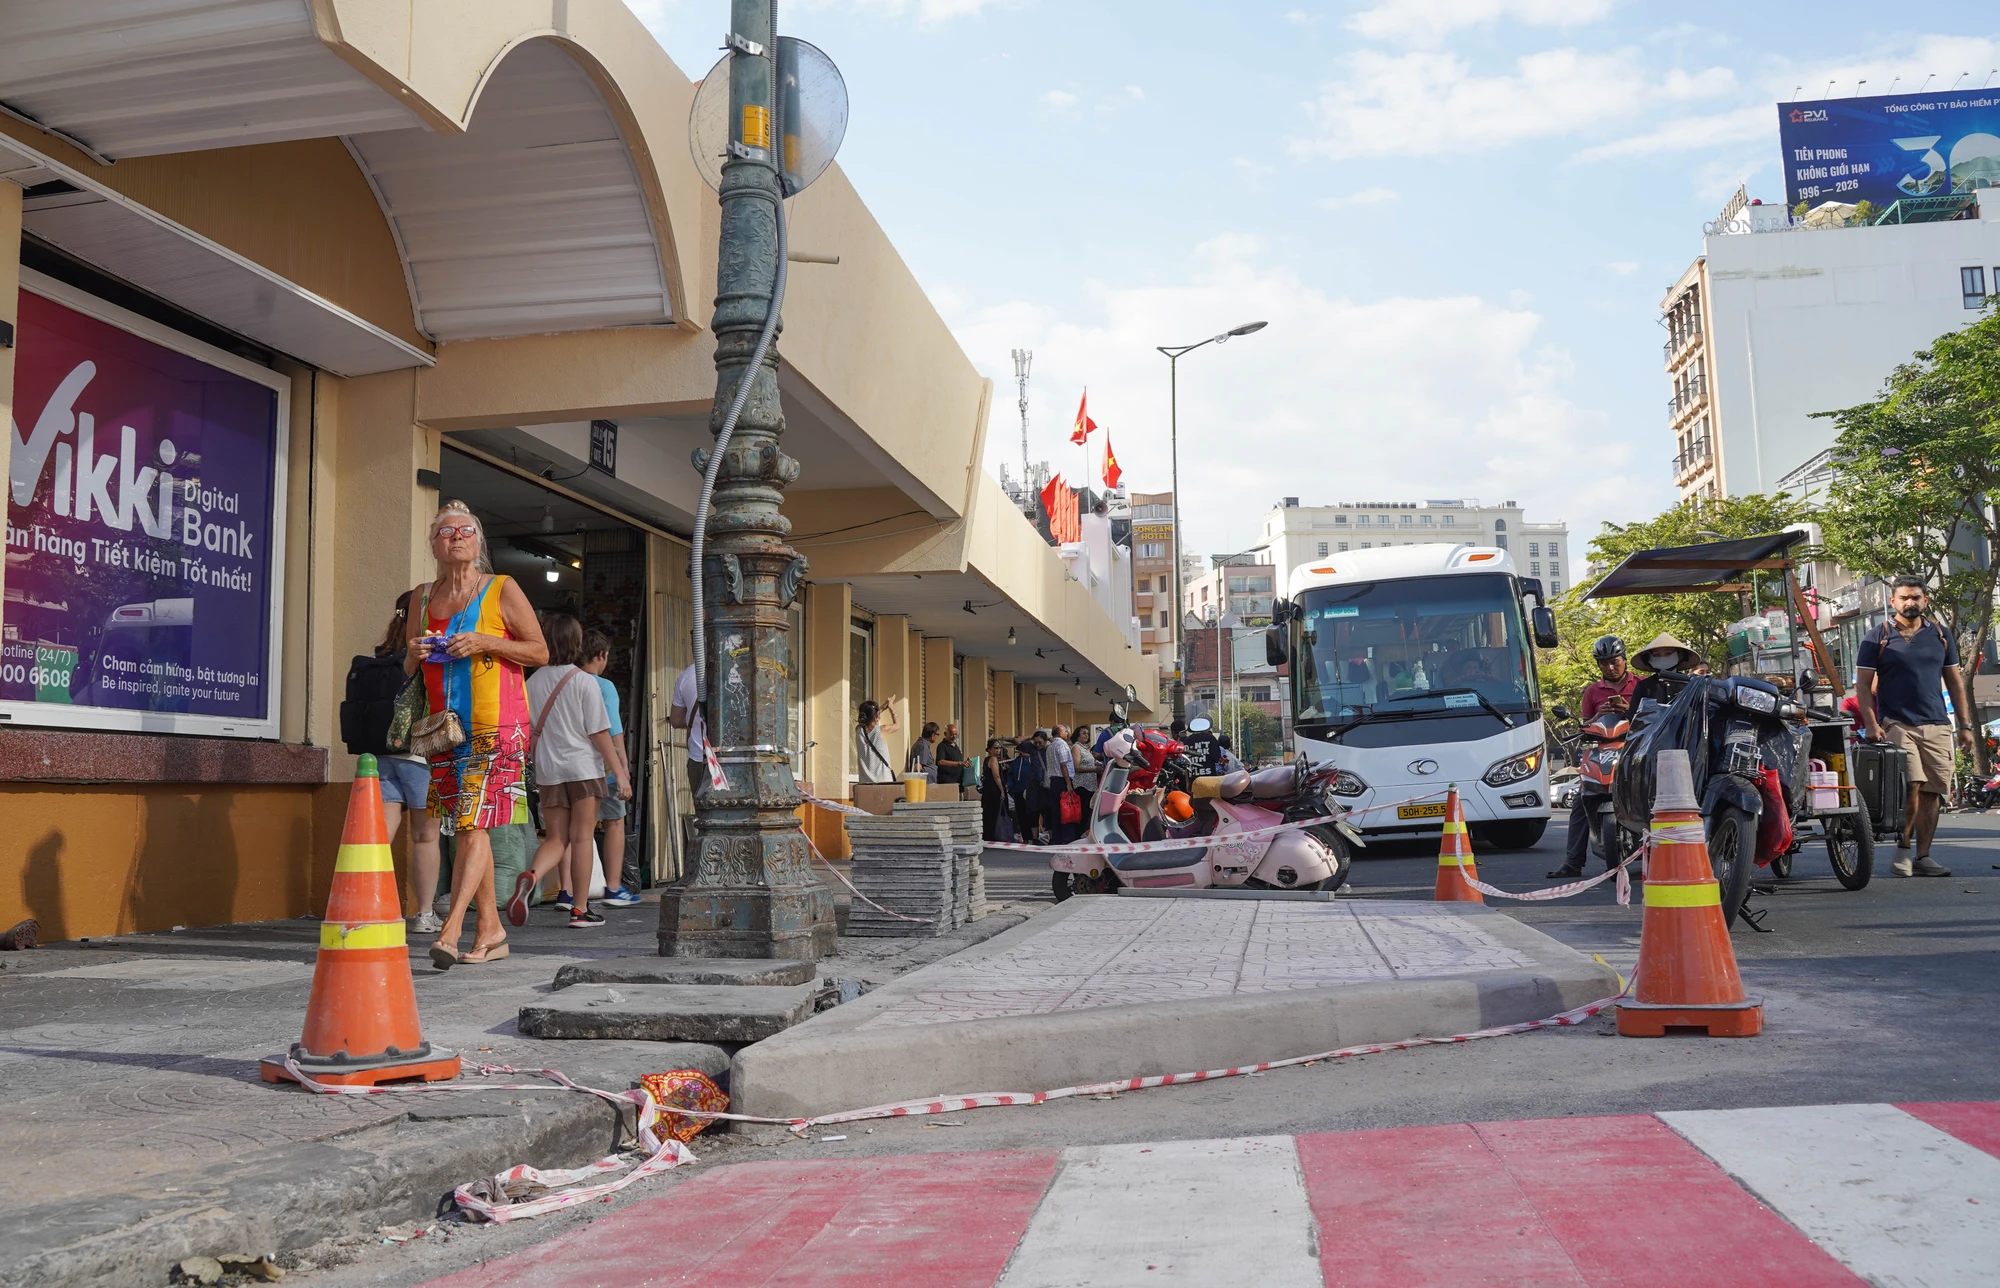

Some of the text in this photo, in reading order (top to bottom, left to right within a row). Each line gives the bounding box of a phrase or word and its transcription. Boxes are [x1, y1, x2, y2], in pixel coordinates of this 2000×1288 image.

[1803, 109, 1827, 119] PVI
[1884, 98, 2000, 113] TỔNG CÔNG TY BẢO HIỂM P
[1794, 146, 1848, 161] TIÊN PHONG
[1796, 162, 1870, 181] KHÔNG GIỚI HẠN
[1798, 185, 1820, 200] 1996
[1835, 179, 1859, 193] 2026
[8, 360, 176, 540] Vikki
[603, 428, 615, 469] 15
[184, 479, 239, 515] Digital
[183, 507, 254, 560] Bank
[1133, 525, 1156, 533] SONG
[1141, 532, 1168, 540] HOTEL
[34, 525, 86, 565] hàng
[91, 538, 130, 568] Tiết
[134, 552, 176, 580] kiệm
[180, 556, 208, 585] Tốt
[211, 566, 252, 592] nhất!
[36, 645, 71, 667] (24/7)
[0, 662, 71, 688] 00 6608
[102, 655, 259, 688] Chạm cảm hứng, bật tương lai
[102, 675, 240, 702] Be inspired, ignite your future
